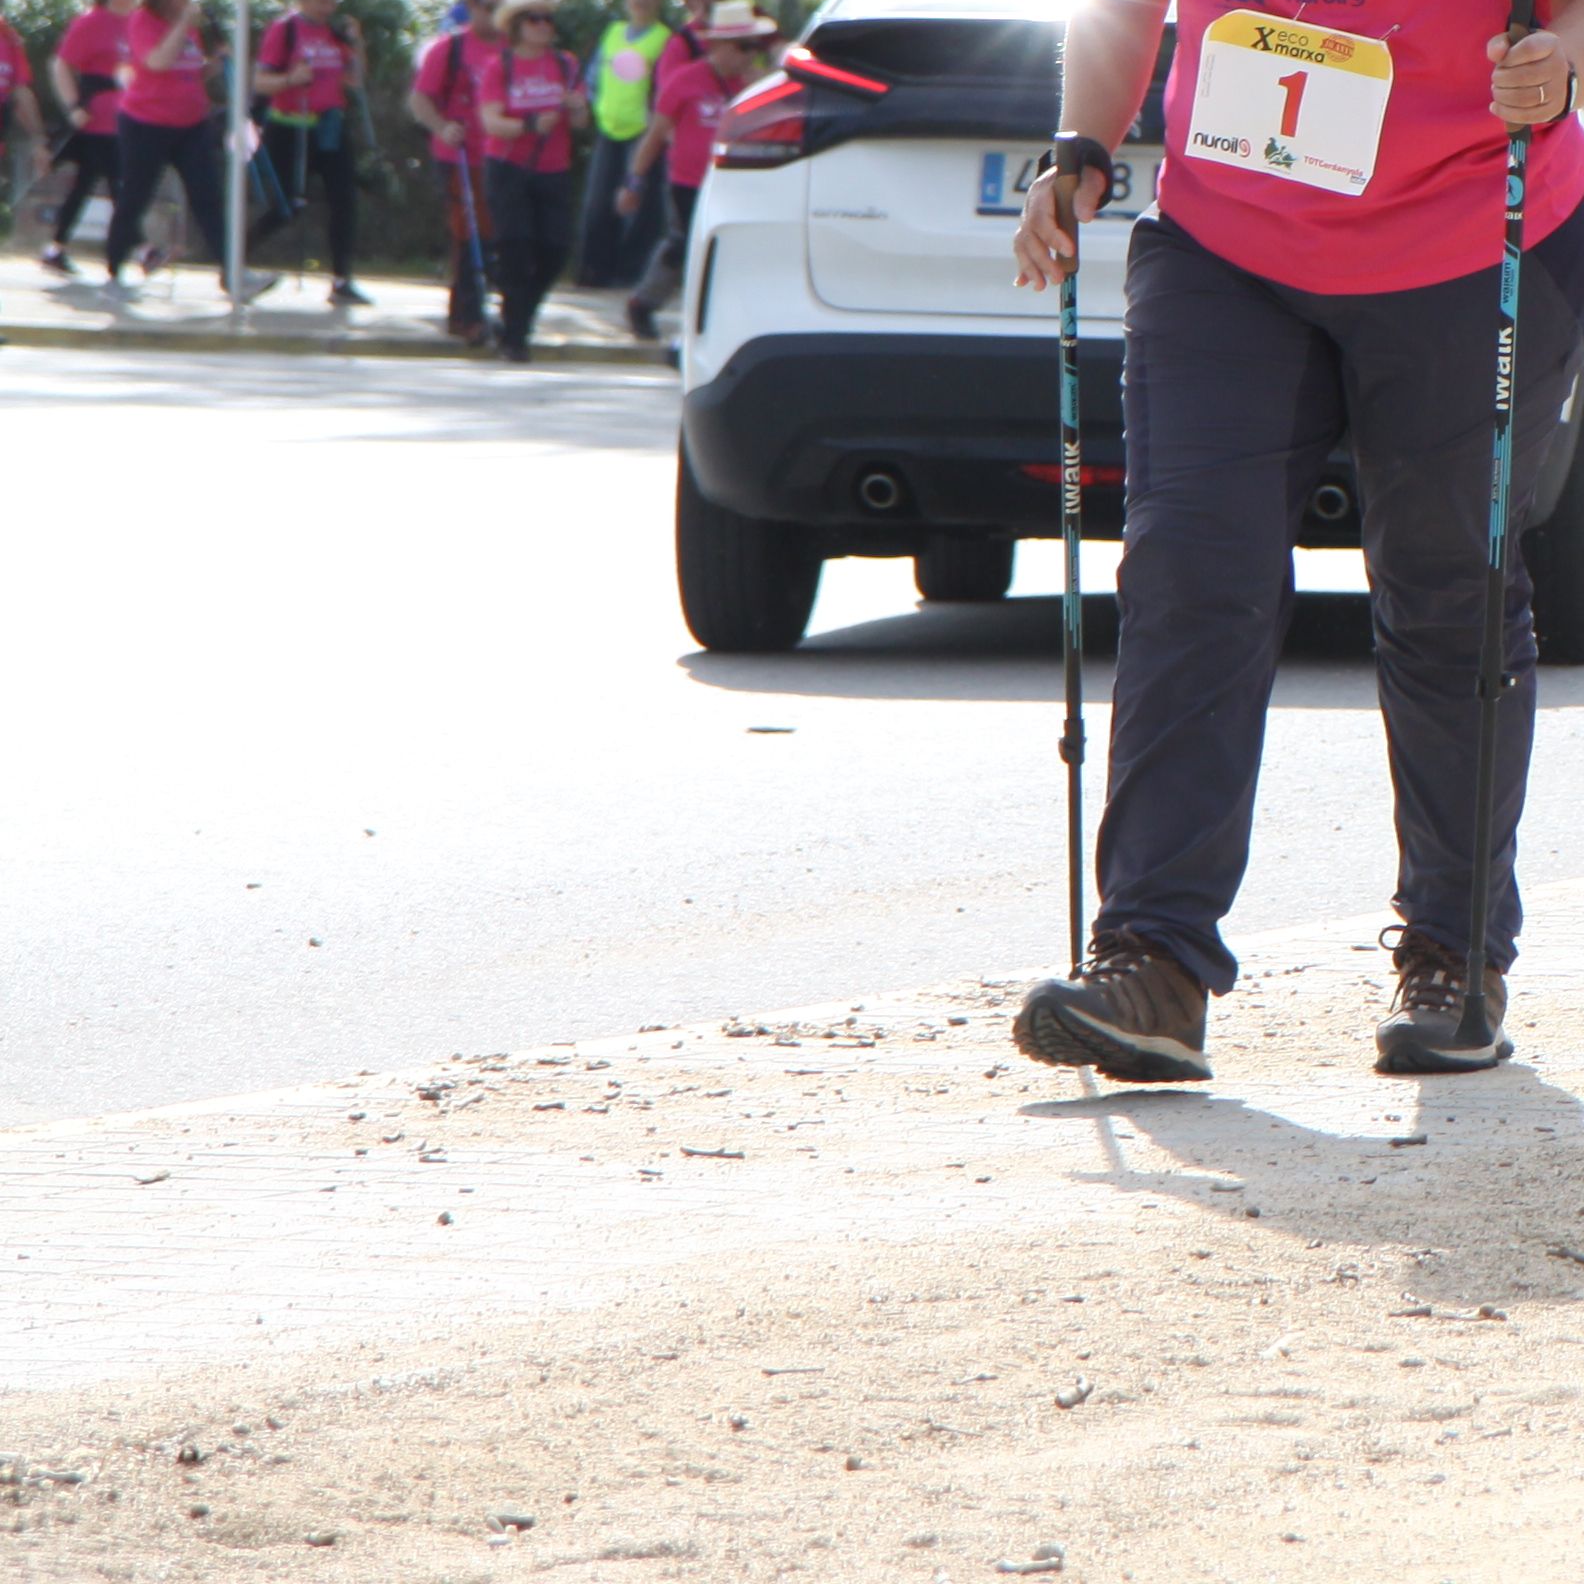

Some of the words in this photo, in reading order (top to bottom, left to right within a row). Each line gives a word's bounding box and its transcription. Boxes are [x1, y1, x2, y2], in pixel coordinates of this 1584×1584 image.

[1251, 26, 1275, 51] X
[1277, 29, 1309, 46] eco
[1274, 43, 1326, 64] marxa
[1278, 70, 1309, 138] 1
[1065, 440, 1081, 515] iwalk
